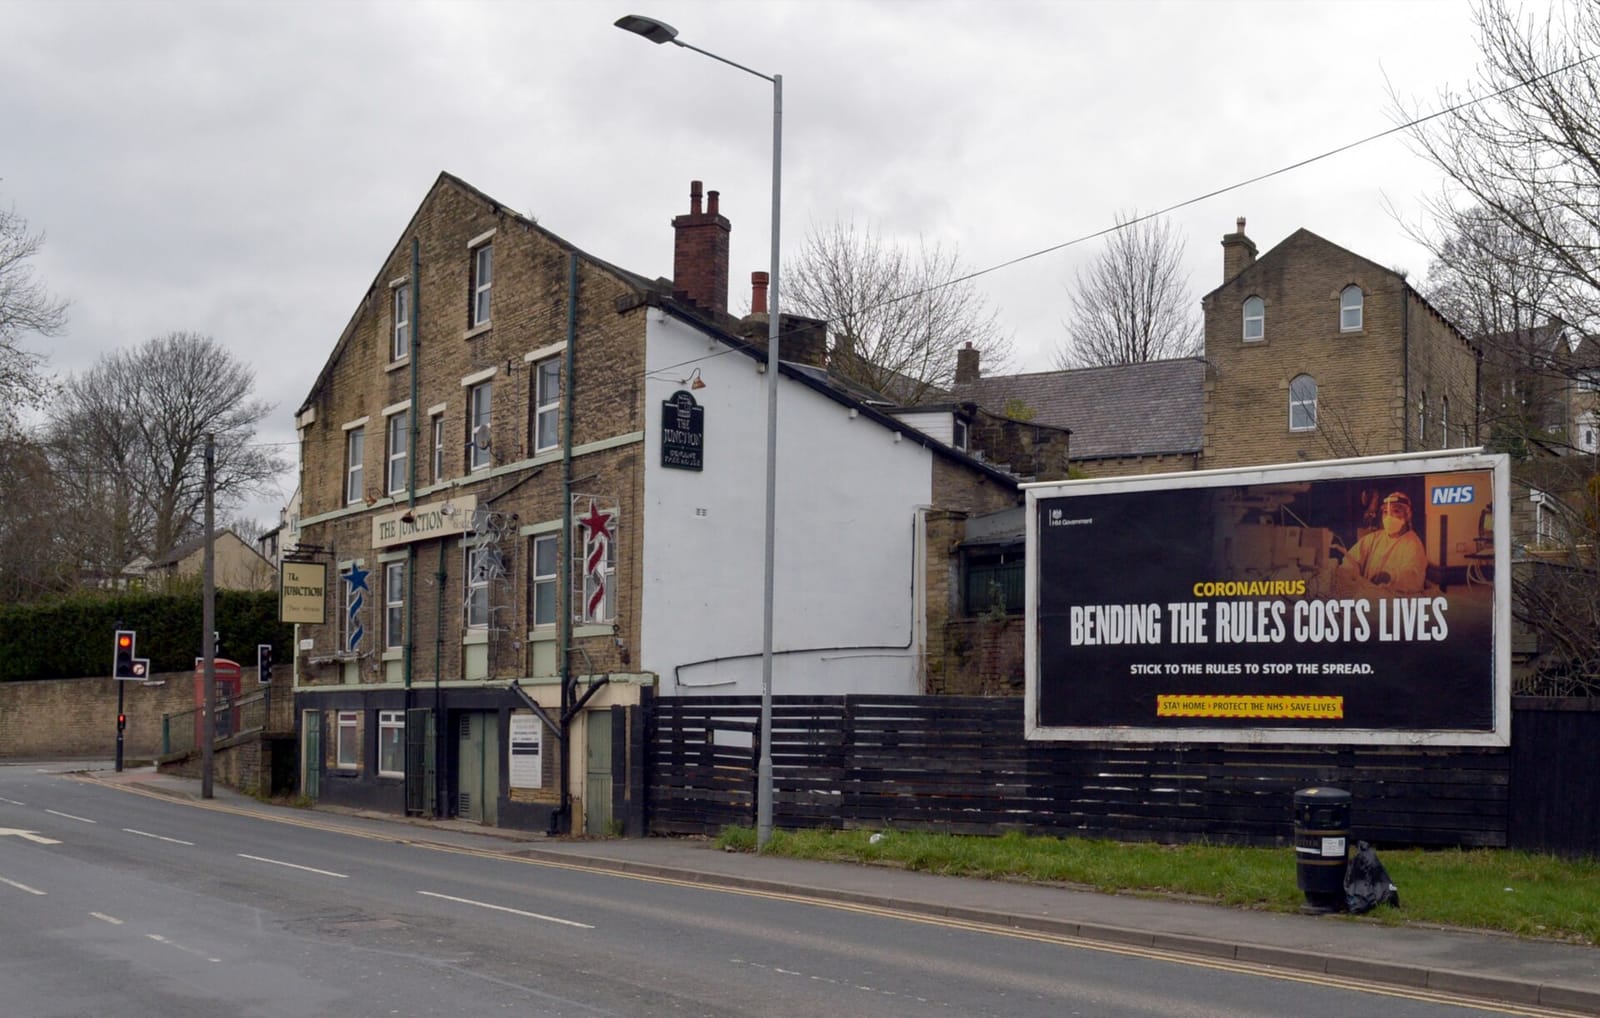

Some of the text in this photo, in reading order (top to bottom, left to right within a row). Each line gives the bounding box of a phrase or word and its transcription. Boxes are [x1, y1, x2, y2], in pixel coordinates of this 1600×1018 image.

[1432, 486, 1473, 504] NHS
[1062, 518, 1092, 526] Government
[379, 520, 396, 540] THE
[284, 586, 322, 597] JUNCTION
[1193, 581, 1306, 596] CORONAVIRUS
[1070, 597, 1449, 646] BENDING THE RULES COSTS LIVES
[1130, 664, 1375, 675] STICK TO THE RULES TO STOP THE SPREAD.
[1163, 702, 1337, 712] STAY HOME PROTECT THE NHS SAVE LIVES
